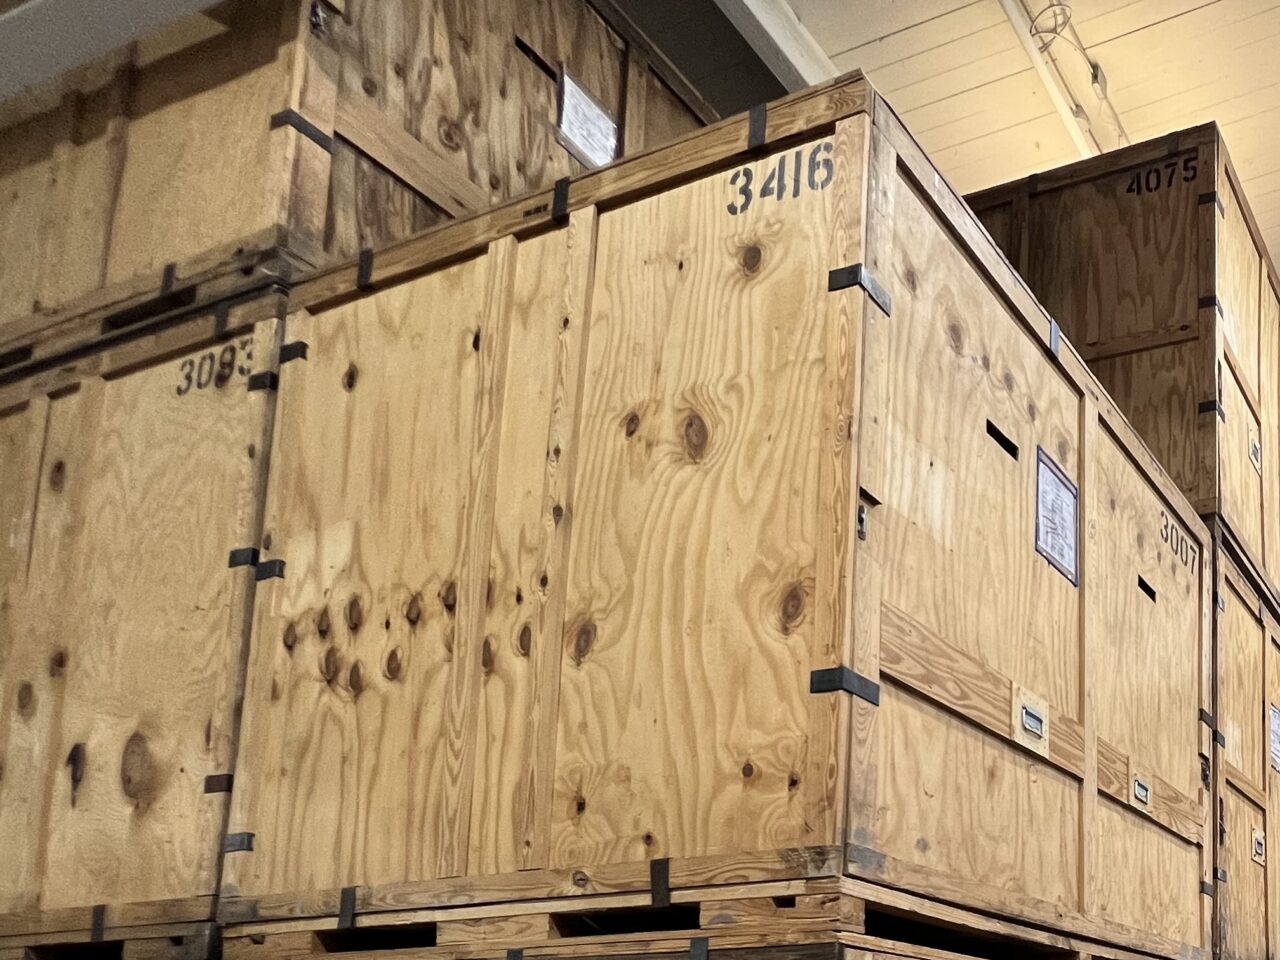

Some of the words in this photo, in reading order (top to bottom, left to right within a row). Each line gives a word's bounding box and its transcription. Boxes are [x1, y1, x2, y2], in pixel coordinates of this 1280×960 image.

[727, 142, 833, 216] 3416
[1126, 157, 1198, 195] 4075
[1160, 510, 1197, 575] 3007
